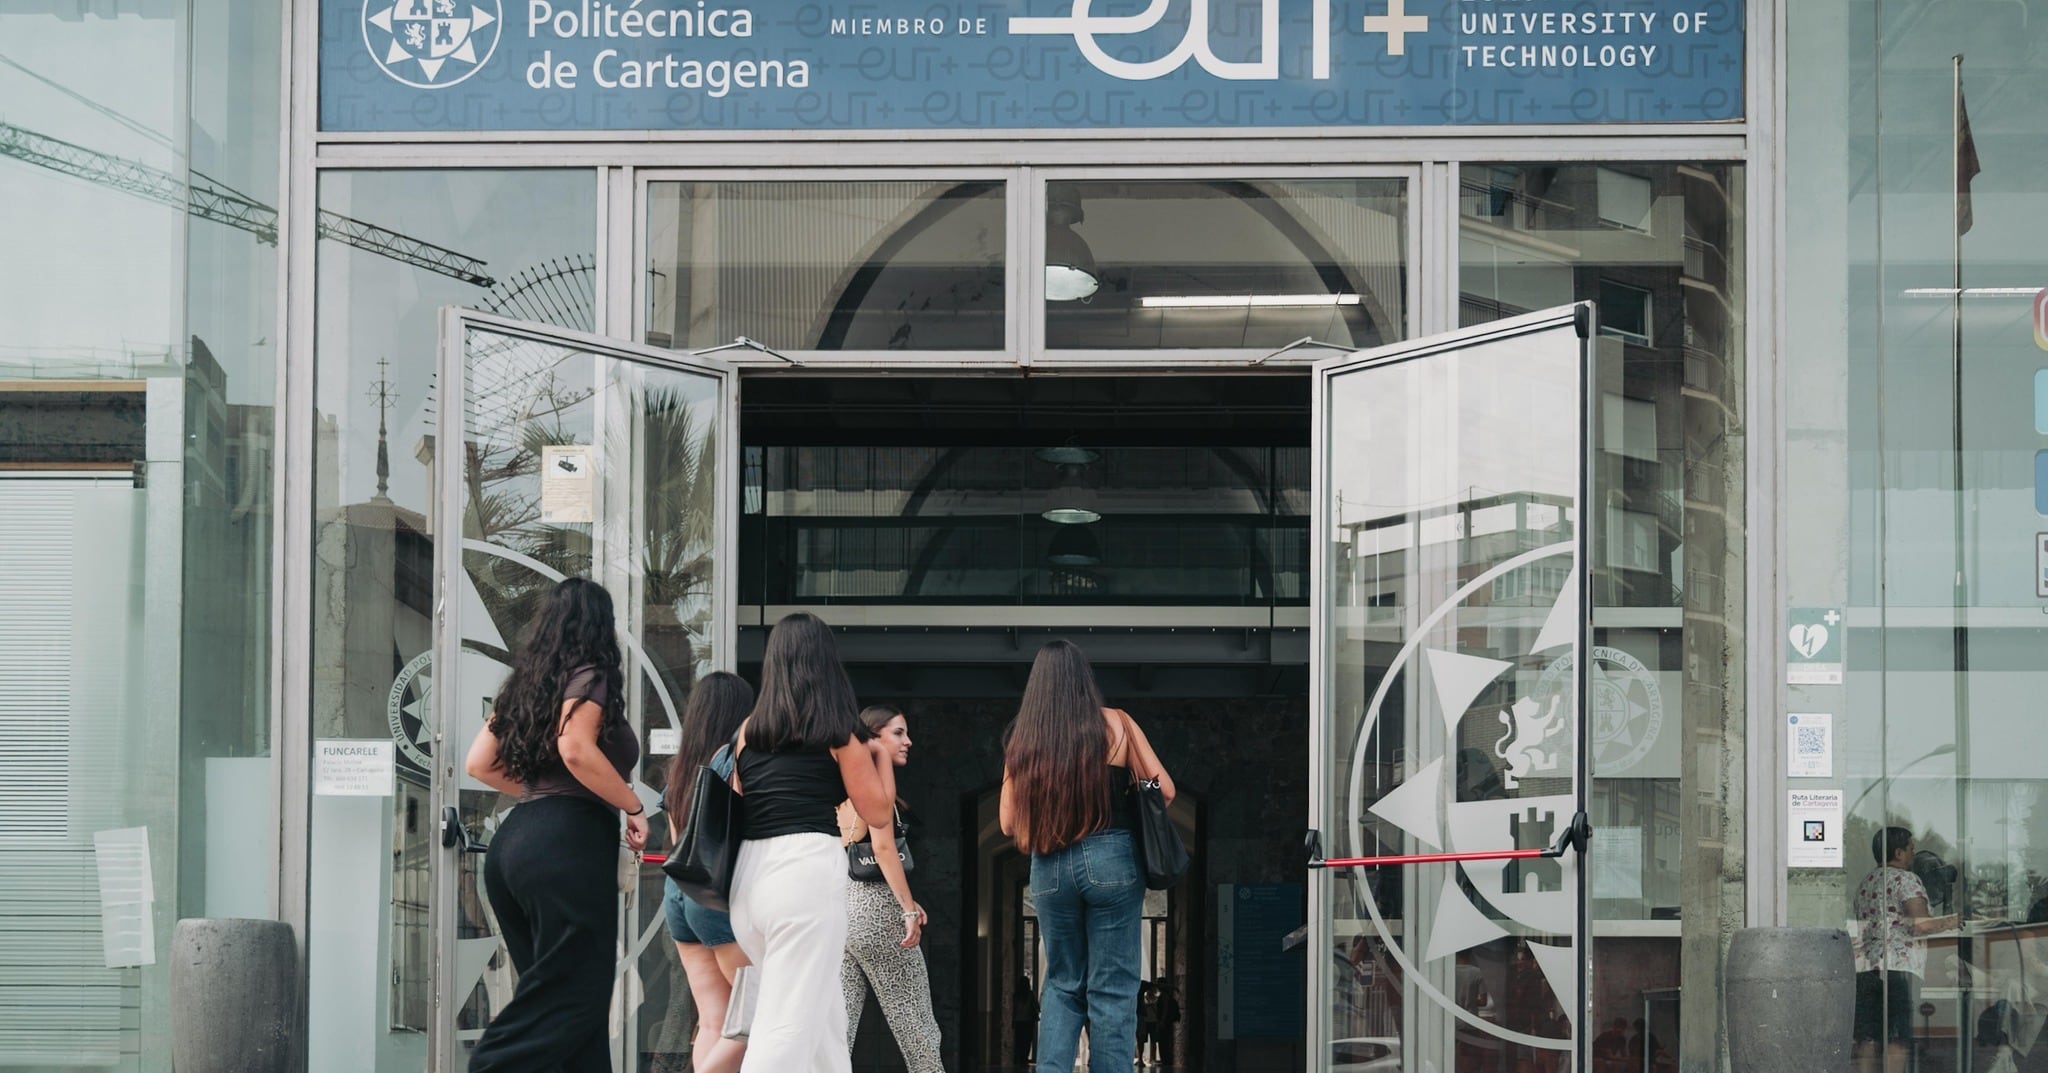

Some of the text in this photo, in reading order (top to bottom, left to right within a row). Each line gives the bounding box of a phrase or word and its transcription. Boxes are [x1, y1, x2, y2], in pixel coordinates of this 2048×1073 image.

[528, 0, 752, 38] Politécnica
[831, 18, 986, 35] MIEMBRO DE
[1461, 12, 1708, 35] UNIVERSITY OF
[1462, 45, 1656, 67] TECHNOLOGY
[526, 48, 809, 98] de Cartagena
[390, 667, 412, 742] UNIVERSIDAD
[323, 747, 379, 756] FUNCARELE
[1802, 800, 1838, 808] Cartagena
[1809, 793, 1838, 801] Literaria
